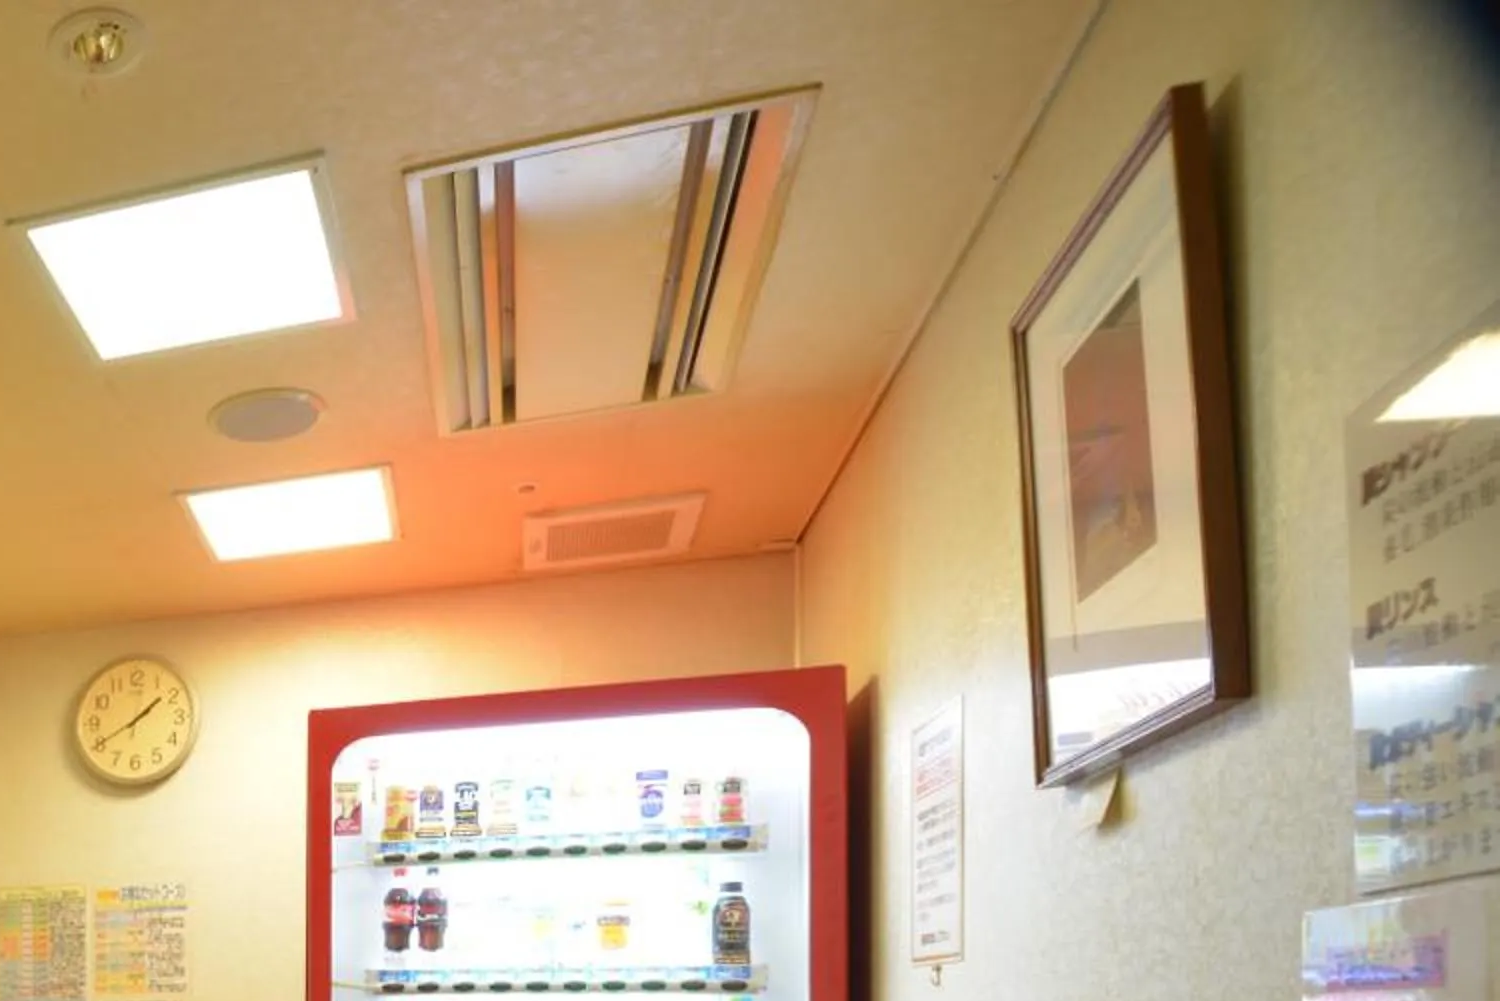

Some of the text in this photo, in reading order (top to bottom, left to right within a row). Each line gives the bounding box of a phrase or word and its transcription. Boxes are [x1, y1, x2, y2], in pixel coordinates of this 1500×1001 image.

[95, 693, 110, 710] 10
[168, 687, 180, 704] 2
[174, 708, 186, 725] 3
[167, 732, 177, 745] 4
[111, 750, 121, 766] 7
[130, 755, 141, 771] 6
[152, 748, 163, 764] 5
